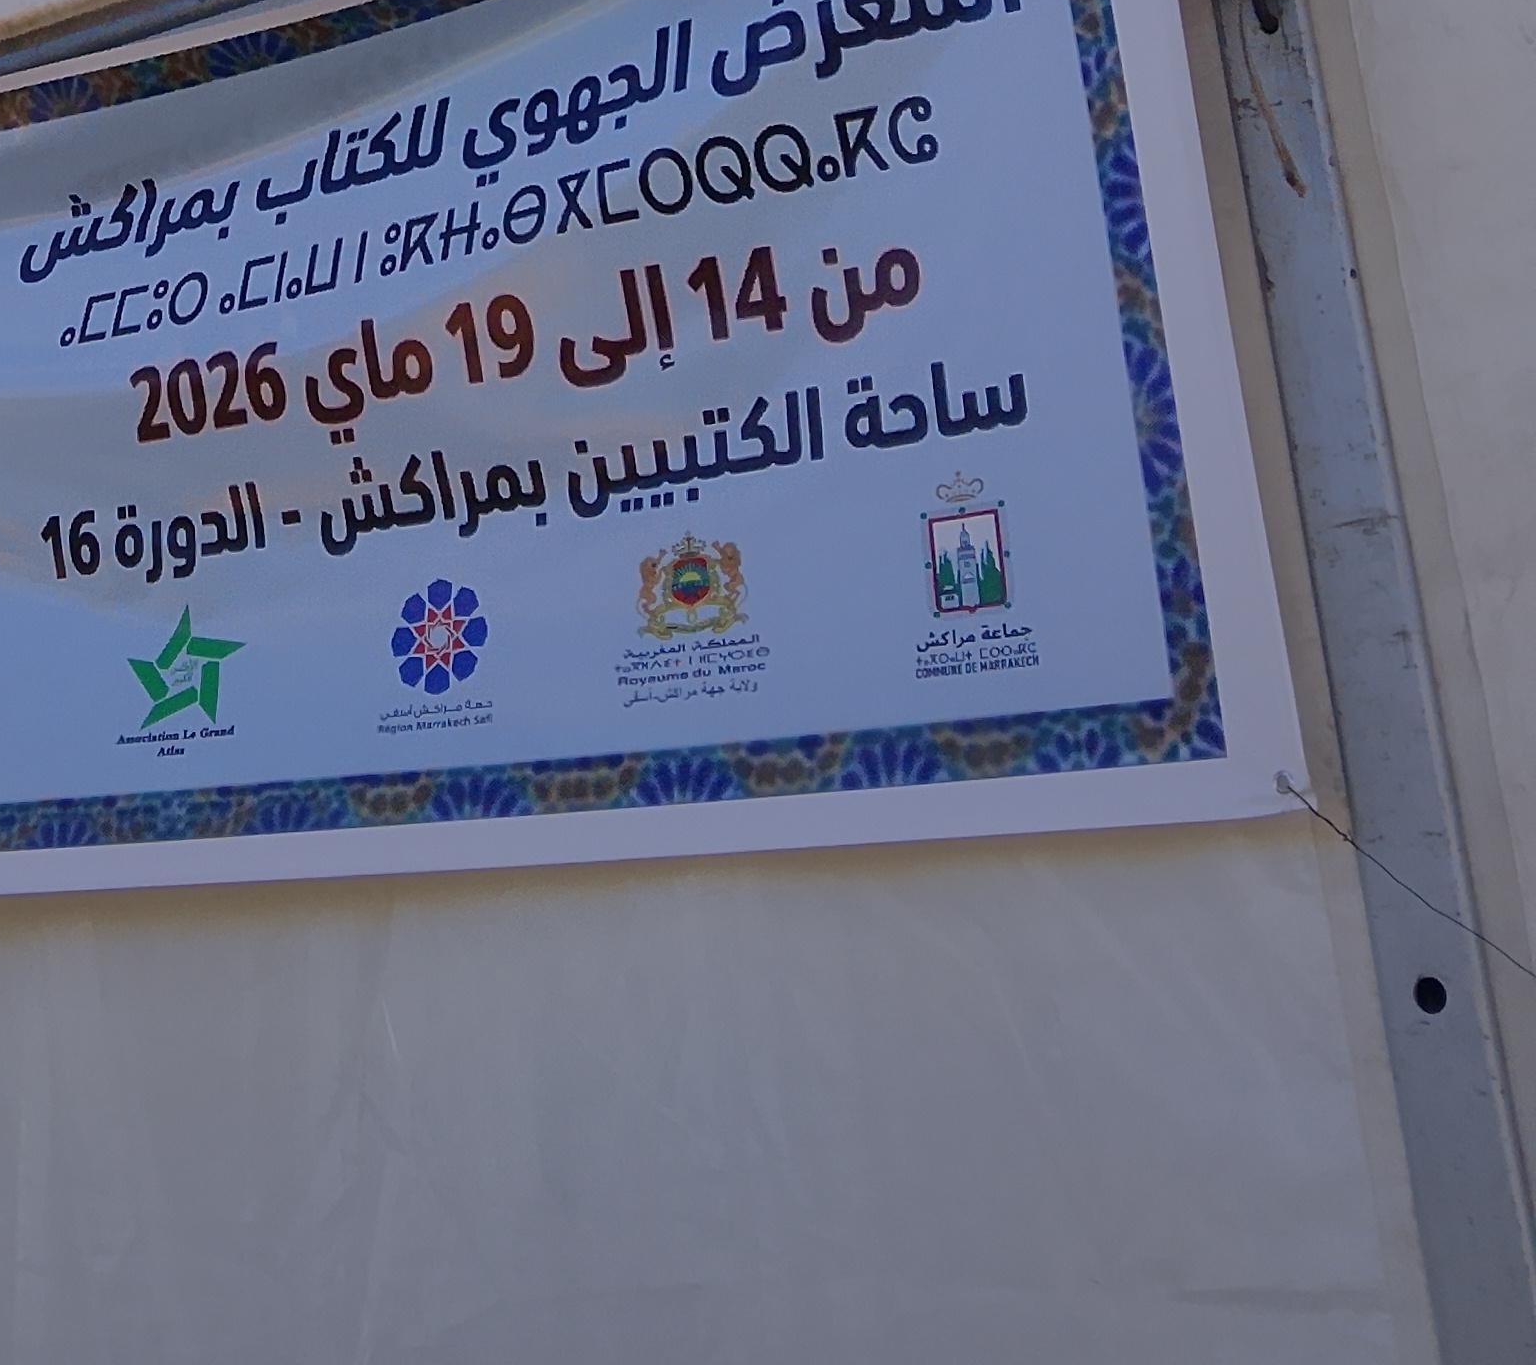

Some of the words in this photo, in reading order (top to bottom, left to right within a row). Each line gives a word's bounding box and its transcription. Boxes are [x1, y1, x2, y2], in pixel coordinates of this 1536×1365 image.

[463, 19, 692, 188] الجهوي
[256, 97, 450, 225] للكتاب
[20, 179, 240, 283] بمراكش
[446, 295, 534, 383] 19
[560, 264, 675, 387] إلى
[688, 246, 787, 340] 14
[812, 248, 919, 342] من
[130, 342, 286, 443] 2026
[306, 319, 432, 445] ماي
[845, 362, 1027, 448] ساحة
[568, 387, 823, 518] الكتبيين
[41, 510, 100, 579] 16
[115, 482, 265, 583] الدورة
[321, 450, 547, 555] بمراكش
[617, 671, 689, 687] Royaume
[692, 667, 712, 678] du
[718, 662, 767, 676] Maroc
[916, 630, 976, 652] مراكش
[965, 661, 977, 674] DE
[980, 655, 1040, 673] MARRAKECH
[981, 623, 1033, 641] جماعة
[115, 731, 179, 745] Association
[183, 729, 197, 740] Le
[199, 725, 235, 739] Grand
[156, 745, 185, 757] Atlas
[415, 716, 471, 731] Marrakech
[473, 712, 493, 725] Safi
